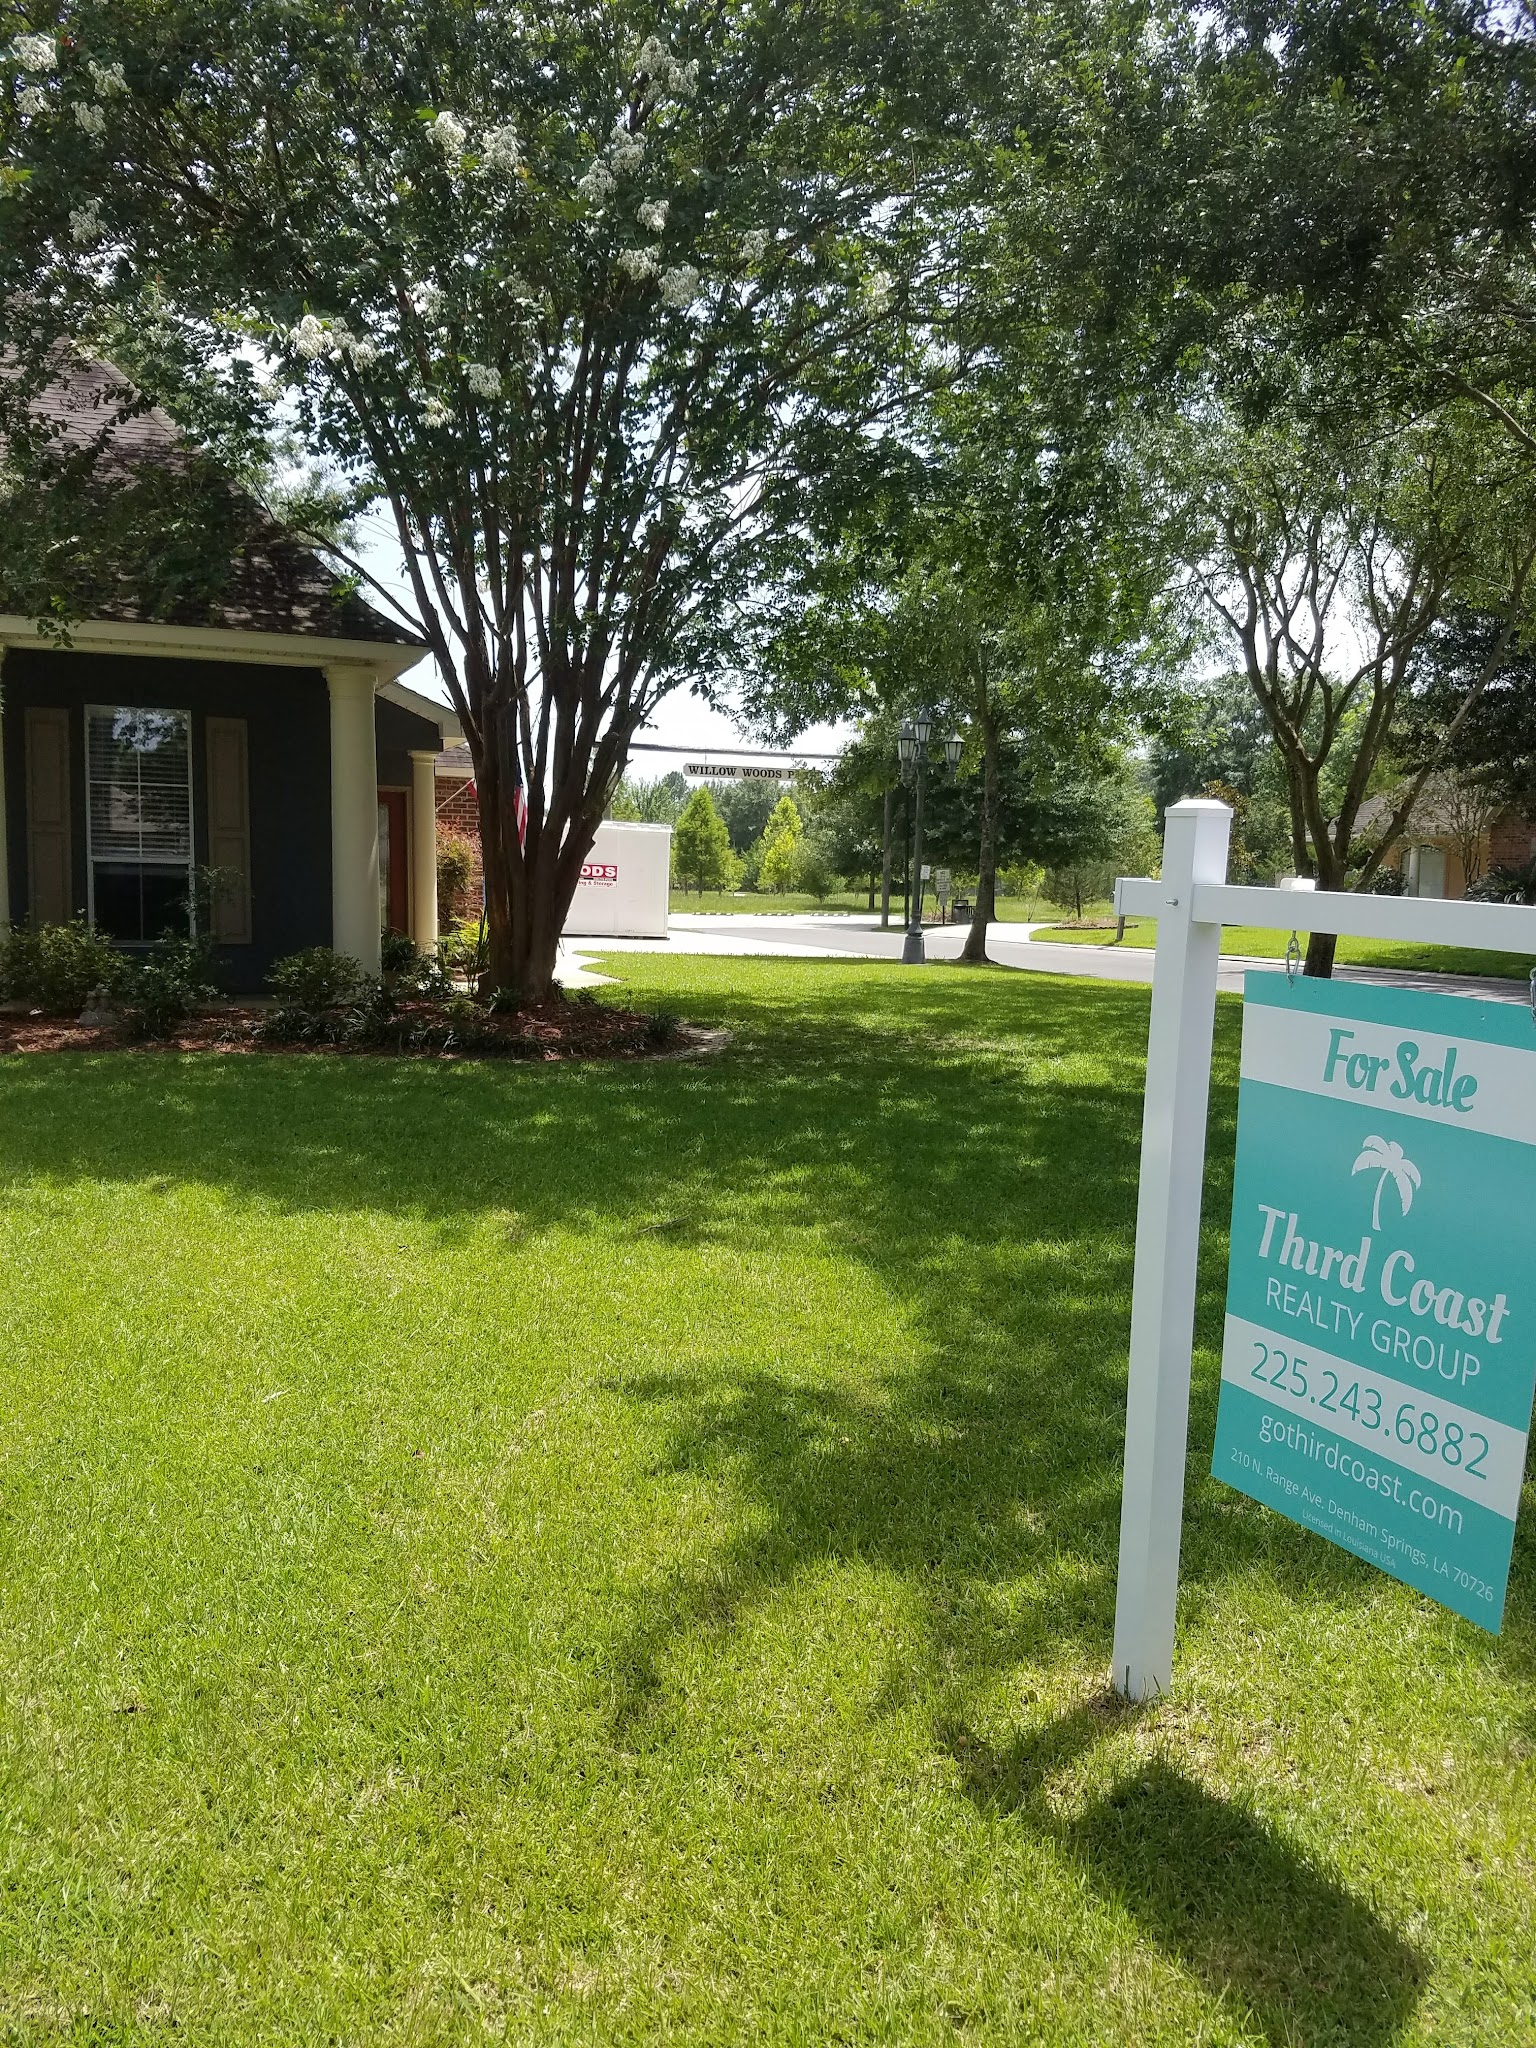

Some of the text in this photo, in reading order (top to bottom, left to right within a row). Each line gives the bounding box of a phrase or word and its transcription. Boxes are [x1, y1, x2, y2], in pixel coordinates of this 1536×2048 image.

[688, 765, 737, 777] WILLOW
[742, 768, 782, 779] WOODS
[580, 865, 616, 877] ODS
[594, 880, 614, 888] Storage
[1323, 1028, 1479, 1113] For Sale
[1257, 1203, 1511, 1344] Third Coast
[1266, 1277, 1480, 1386] REALTY GROUP
[1250, 1342, 1489, 1480] 225.243.6882
[1259, 1414, 1463, 1534] gothirdcoast.com
[1230, 1447, 1494, 1602] 210 N. Range Ave. Denham Springs, LA 70726
[1302, 1508, 1396, 1569] Licensed in Louisiana USA
